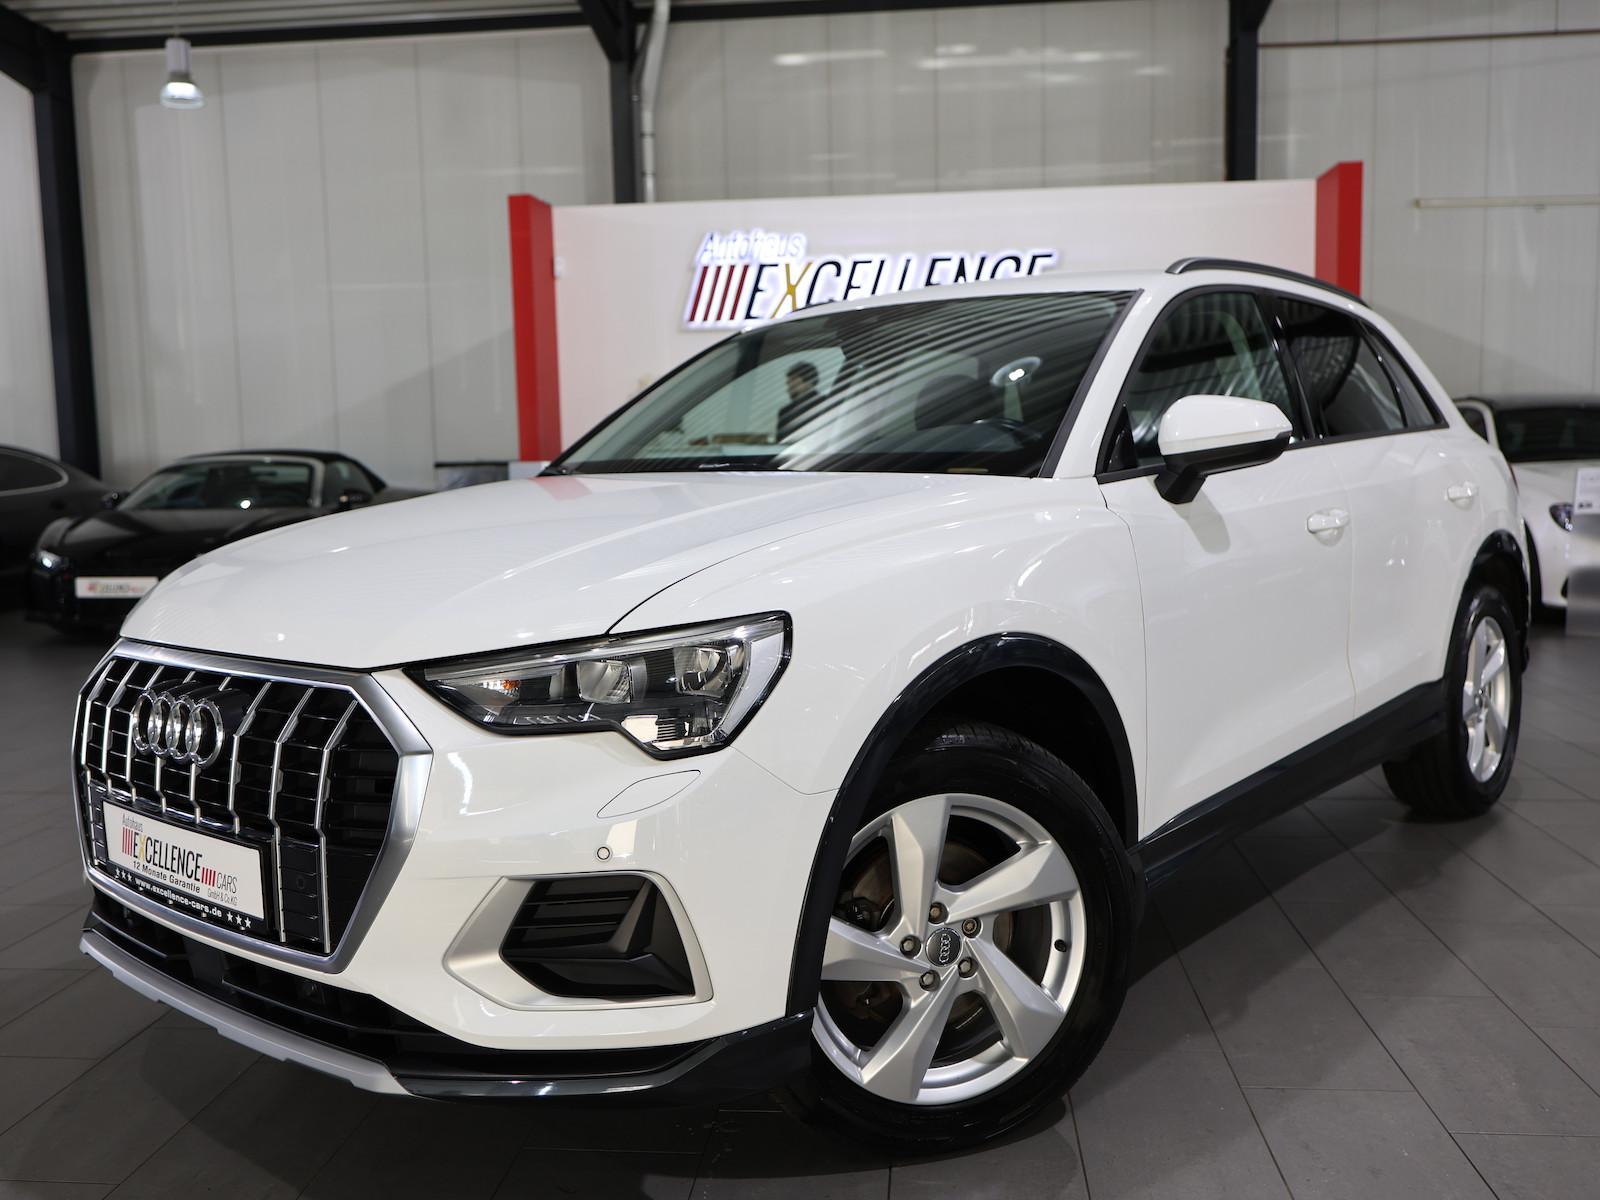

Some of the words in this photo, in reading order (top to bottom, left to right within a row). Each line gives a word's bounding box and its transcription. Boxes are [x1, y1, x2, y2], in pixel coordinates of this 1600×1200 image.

[701, 230, 803, 261] Autohaus
[121, 813, 144, 832] Autohaus
[132, 831, 203, 882] EXCELLENCE
[217, 872, 238, 894] CARS
[132, 861, 141, 871] 12
[142, 864, 167, 881] Monate
[169, 874, 201, 894] Garantie
[134, 877, 223, 918] www.excellence-cars.de
